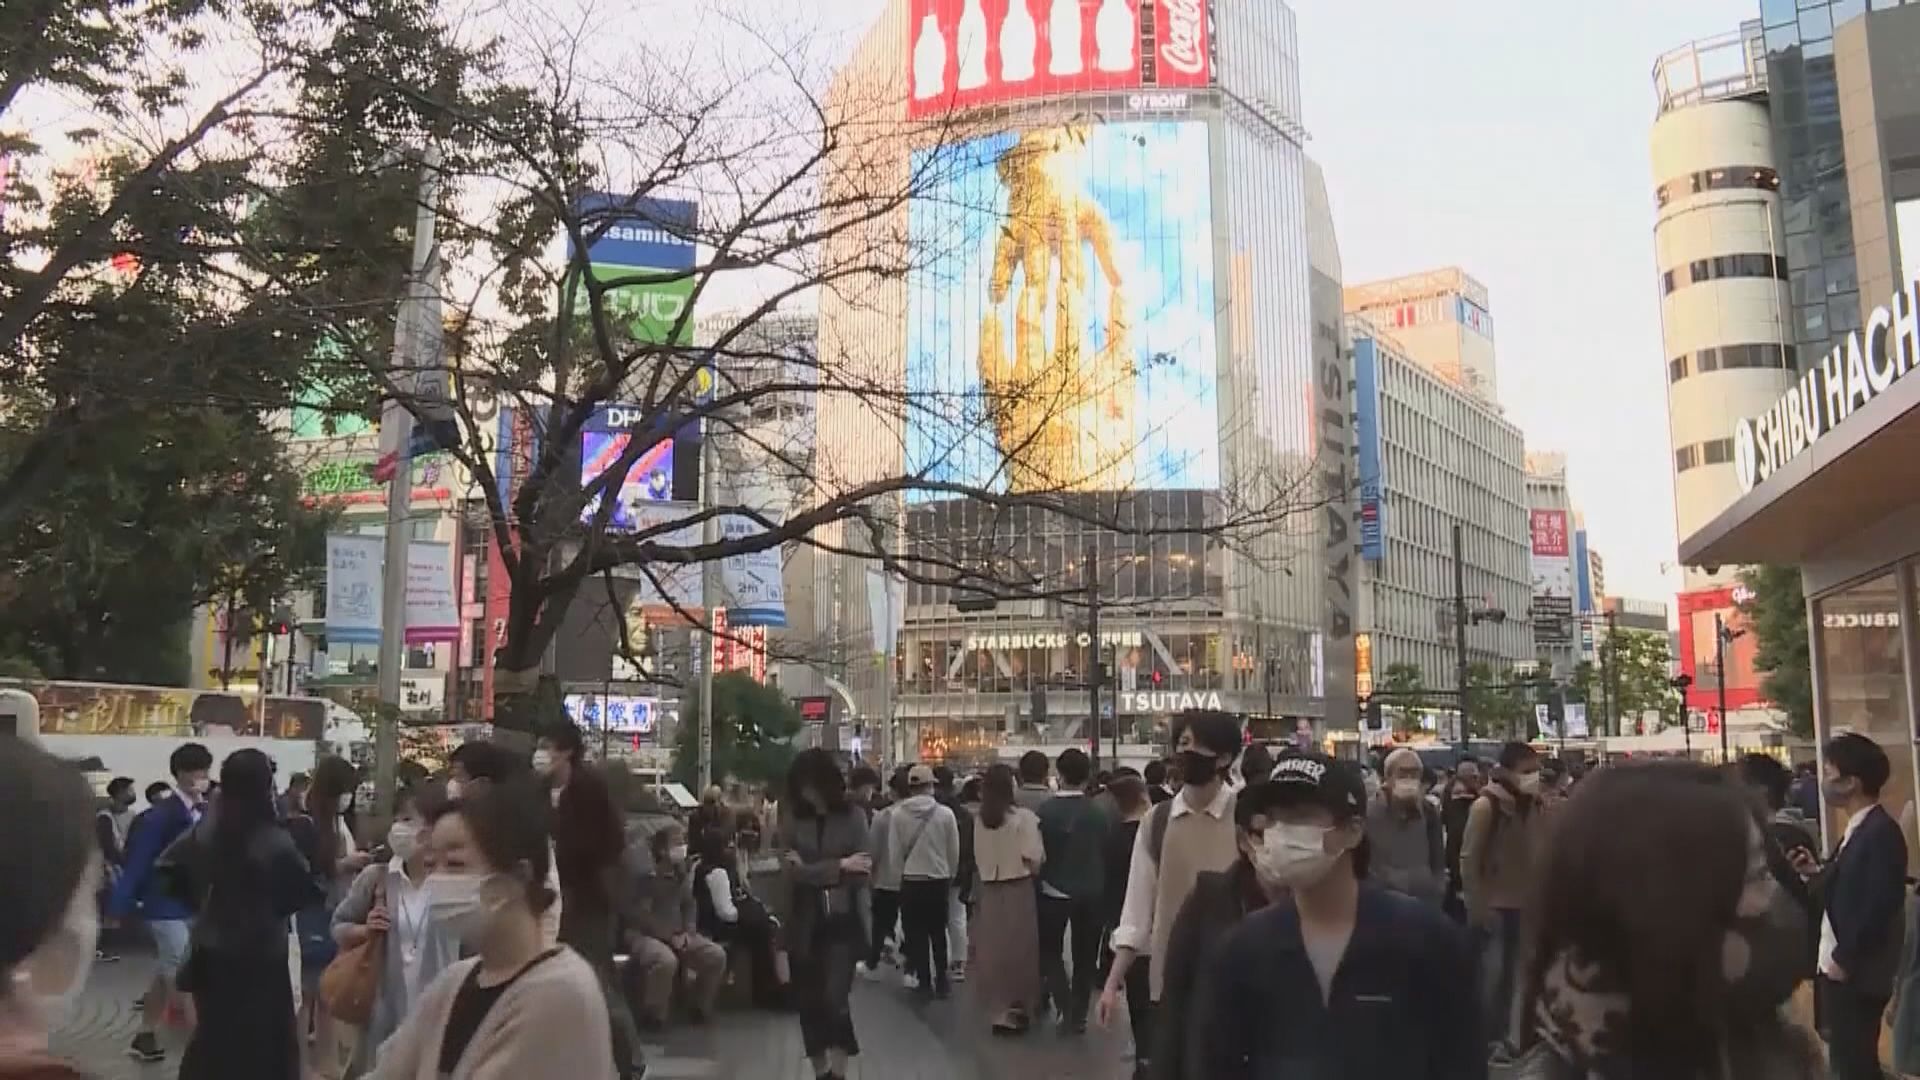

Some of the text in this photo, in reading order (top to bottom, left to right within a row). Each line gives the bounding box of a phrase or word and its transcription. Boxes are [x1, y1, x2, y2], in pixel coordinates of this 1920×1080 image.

[607, 407, 643, 427] DH
[1756, 368, 1820, 481] SHIBU
[1318, 320, 1351, 642] TSUTAYA
[967, 630, 1143, 650] STARBUCKS CFFEE
[1120, 691, 1222, 712] TSUTAYA
